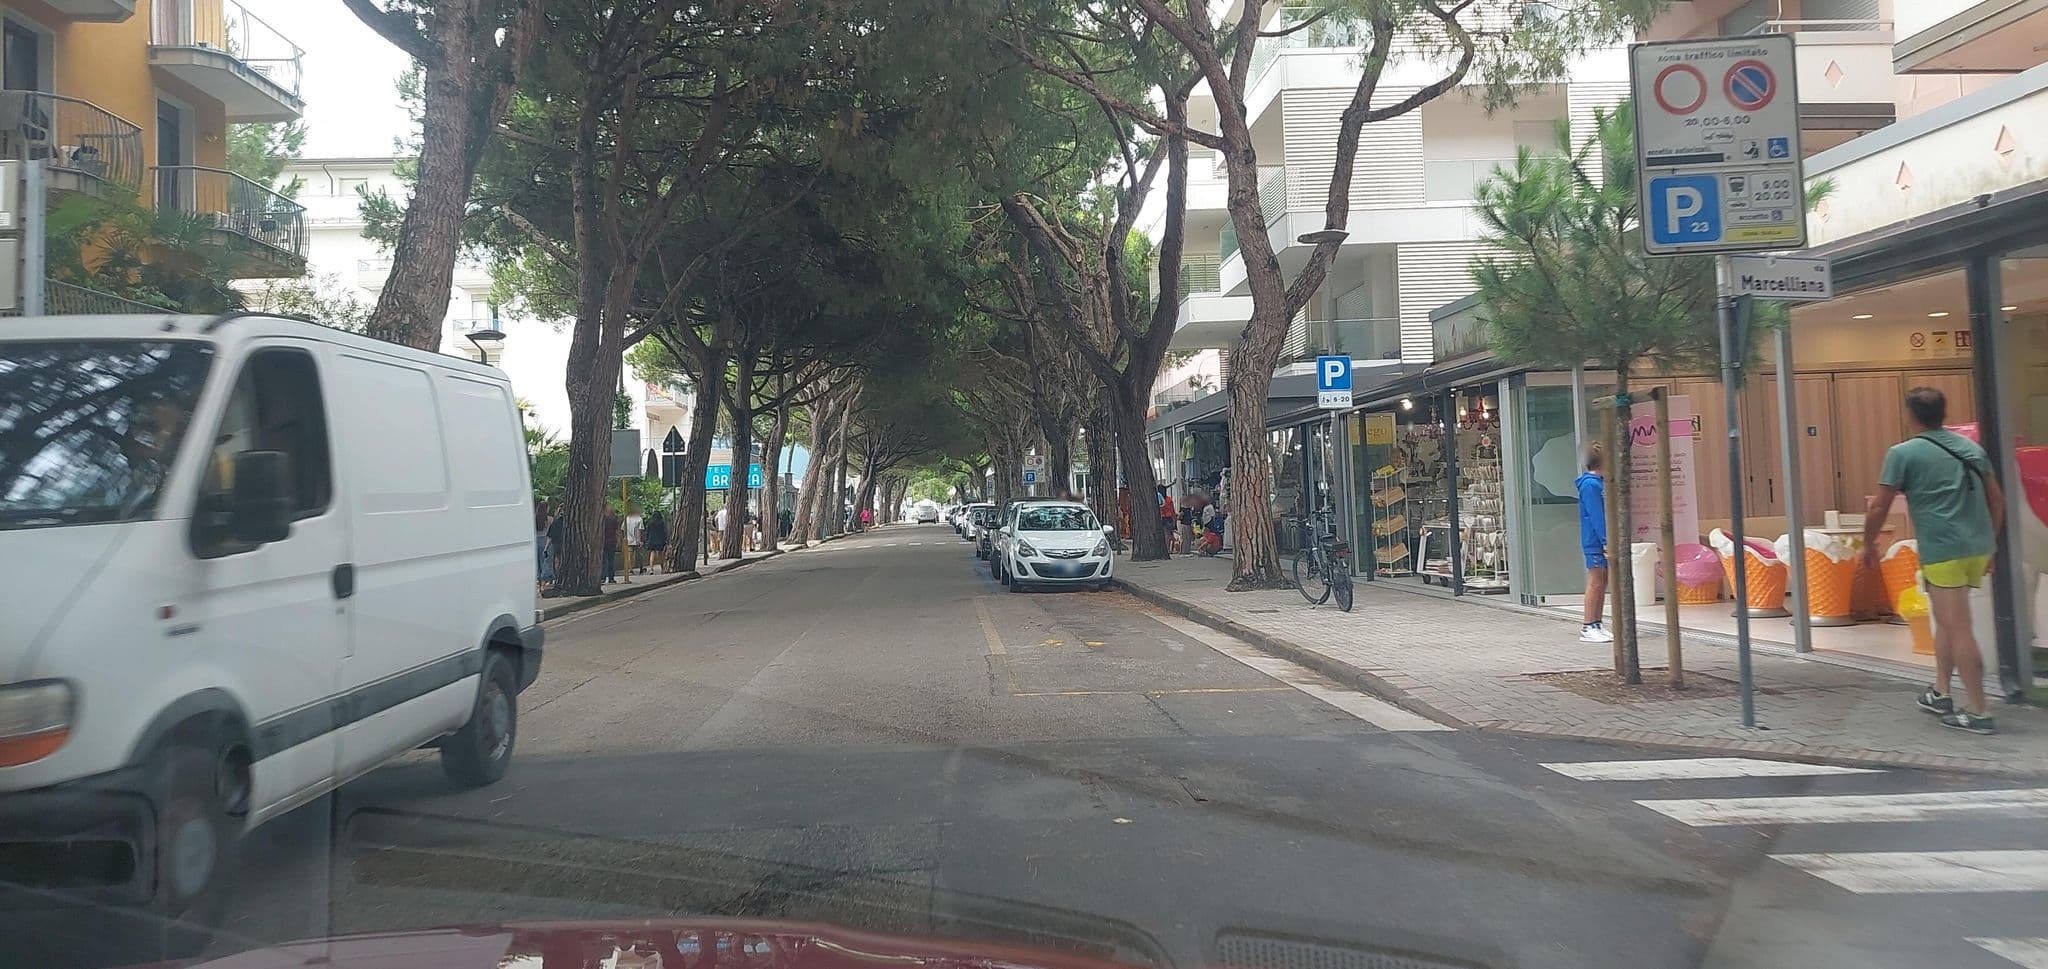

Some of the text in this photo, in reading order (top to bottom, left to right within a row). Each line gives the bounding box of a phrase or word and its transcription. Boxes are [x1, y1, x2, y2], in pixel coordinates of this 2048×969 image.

[1657, 48, 1769, 62] zona traffico limitato
[1762, 179, 1790, 190] 9.00
[1754, 190, 1791, 202] 20.00
[1666, 187, 1703, 234] P
[1691, 221, 1709, 233] 23
[1741, 275, 1825, 292] Marcelliana
[1324, 360, 1345, 387] P
[712, 474, 760, 487] BRA
